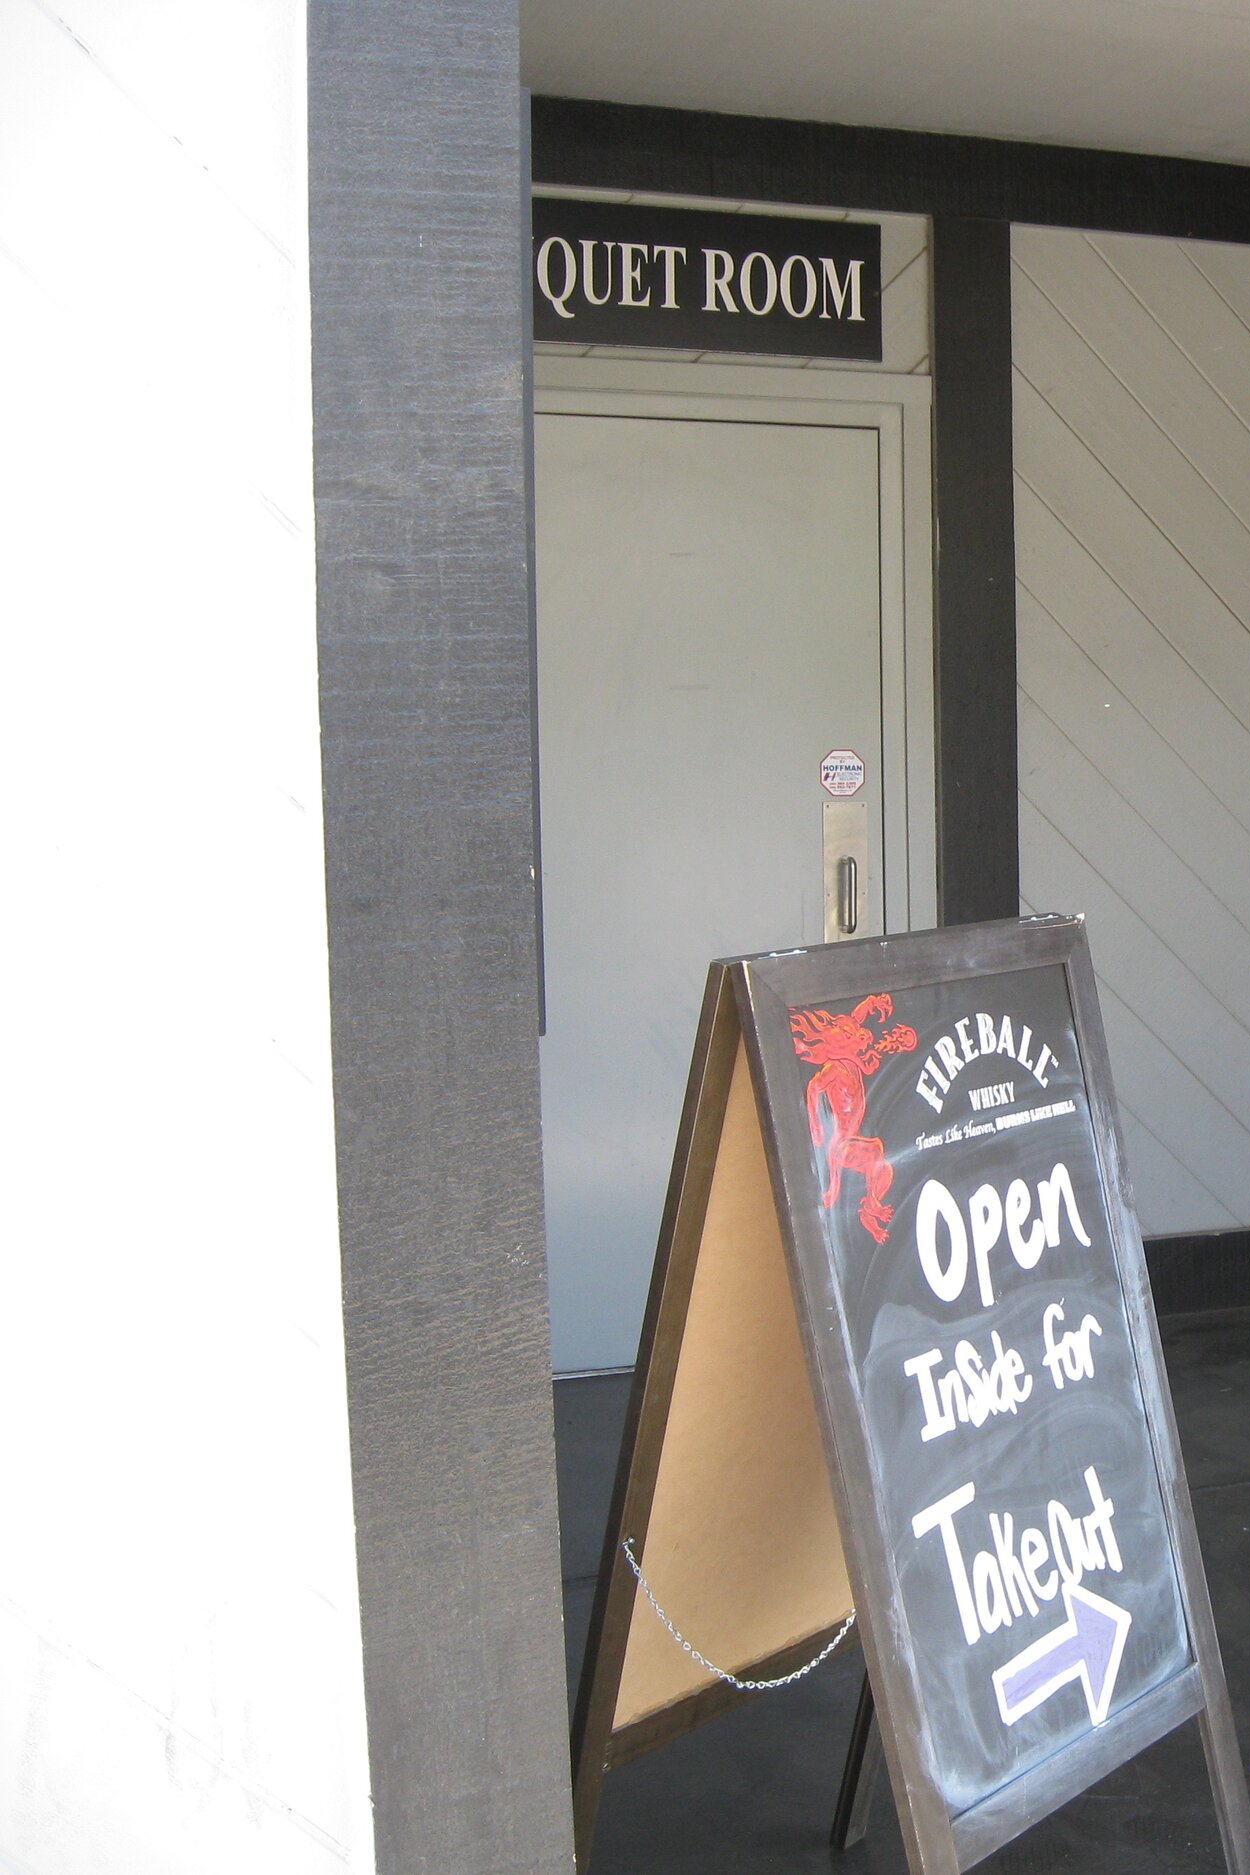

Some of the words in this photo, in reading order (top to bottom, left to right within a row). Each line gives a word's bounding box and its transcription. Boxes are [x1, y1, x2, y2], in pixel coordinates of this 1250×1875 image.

[533, 235, 688, 320] QUET
[700, 247, 867, 322] ROOM
[915, 1131, 944, 1150] Tastes
[944, 1122, 963, 1144] Like
[963, 1119, 997, 1138] Heaven,
[1029, 1105, 1053, 1122] LIKE
[968, 1081, 1015, 1111] WHISKY
[916, 1162, 1092, 1308] Open
[1042, 1302, 1103, 1390] for
